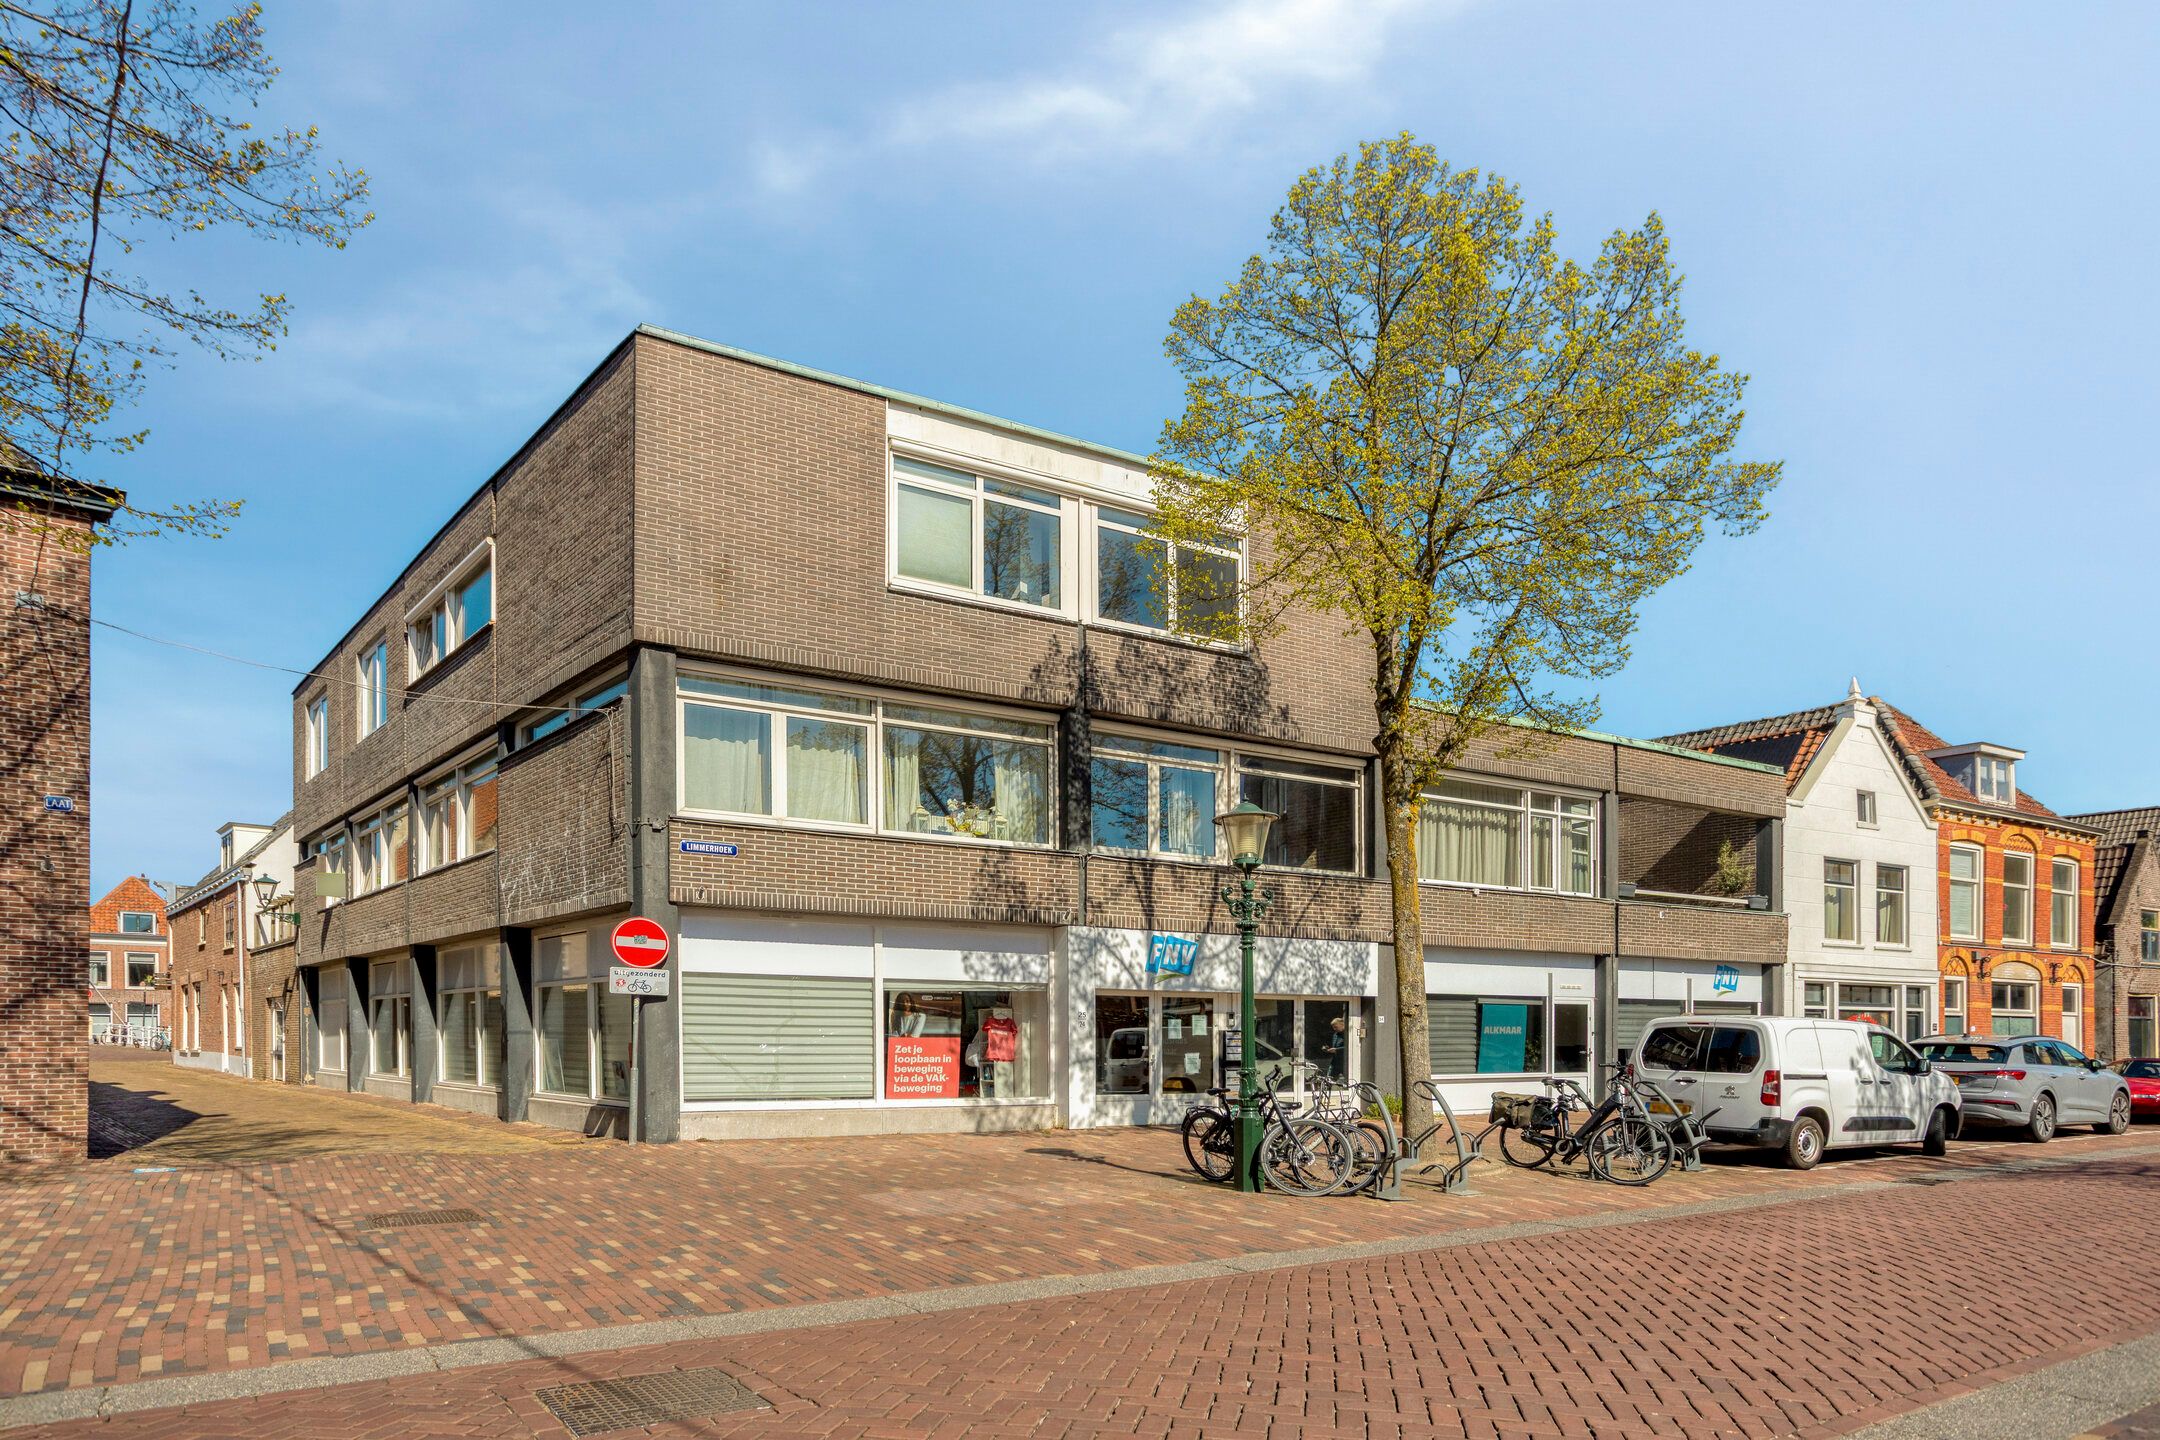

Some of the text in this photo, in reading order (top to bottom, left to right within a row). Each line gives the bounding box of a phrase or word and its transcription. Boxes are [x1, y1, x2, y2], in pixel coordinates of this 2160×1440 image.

[45, 798, 70, 808] LAAT
[686, 842, 733, 854] LIMMERHOEK
[1149, 943, 1197, 966] FNV
[614, 970, 666, 978] uitgezonderd
[1715, 969, 1739, 986] FNV
[1484, 1026, 1522, 1034] ALKMAAR
[895, 1045, 923, 1055] Zet je
[894, 1054, 952, 1064] loopbaan in
[894, 1064, 943, 1074] beweging
[894, 1074, 949, 1083] via de VAK-
[893, 1083, 942, 1093] beweging
